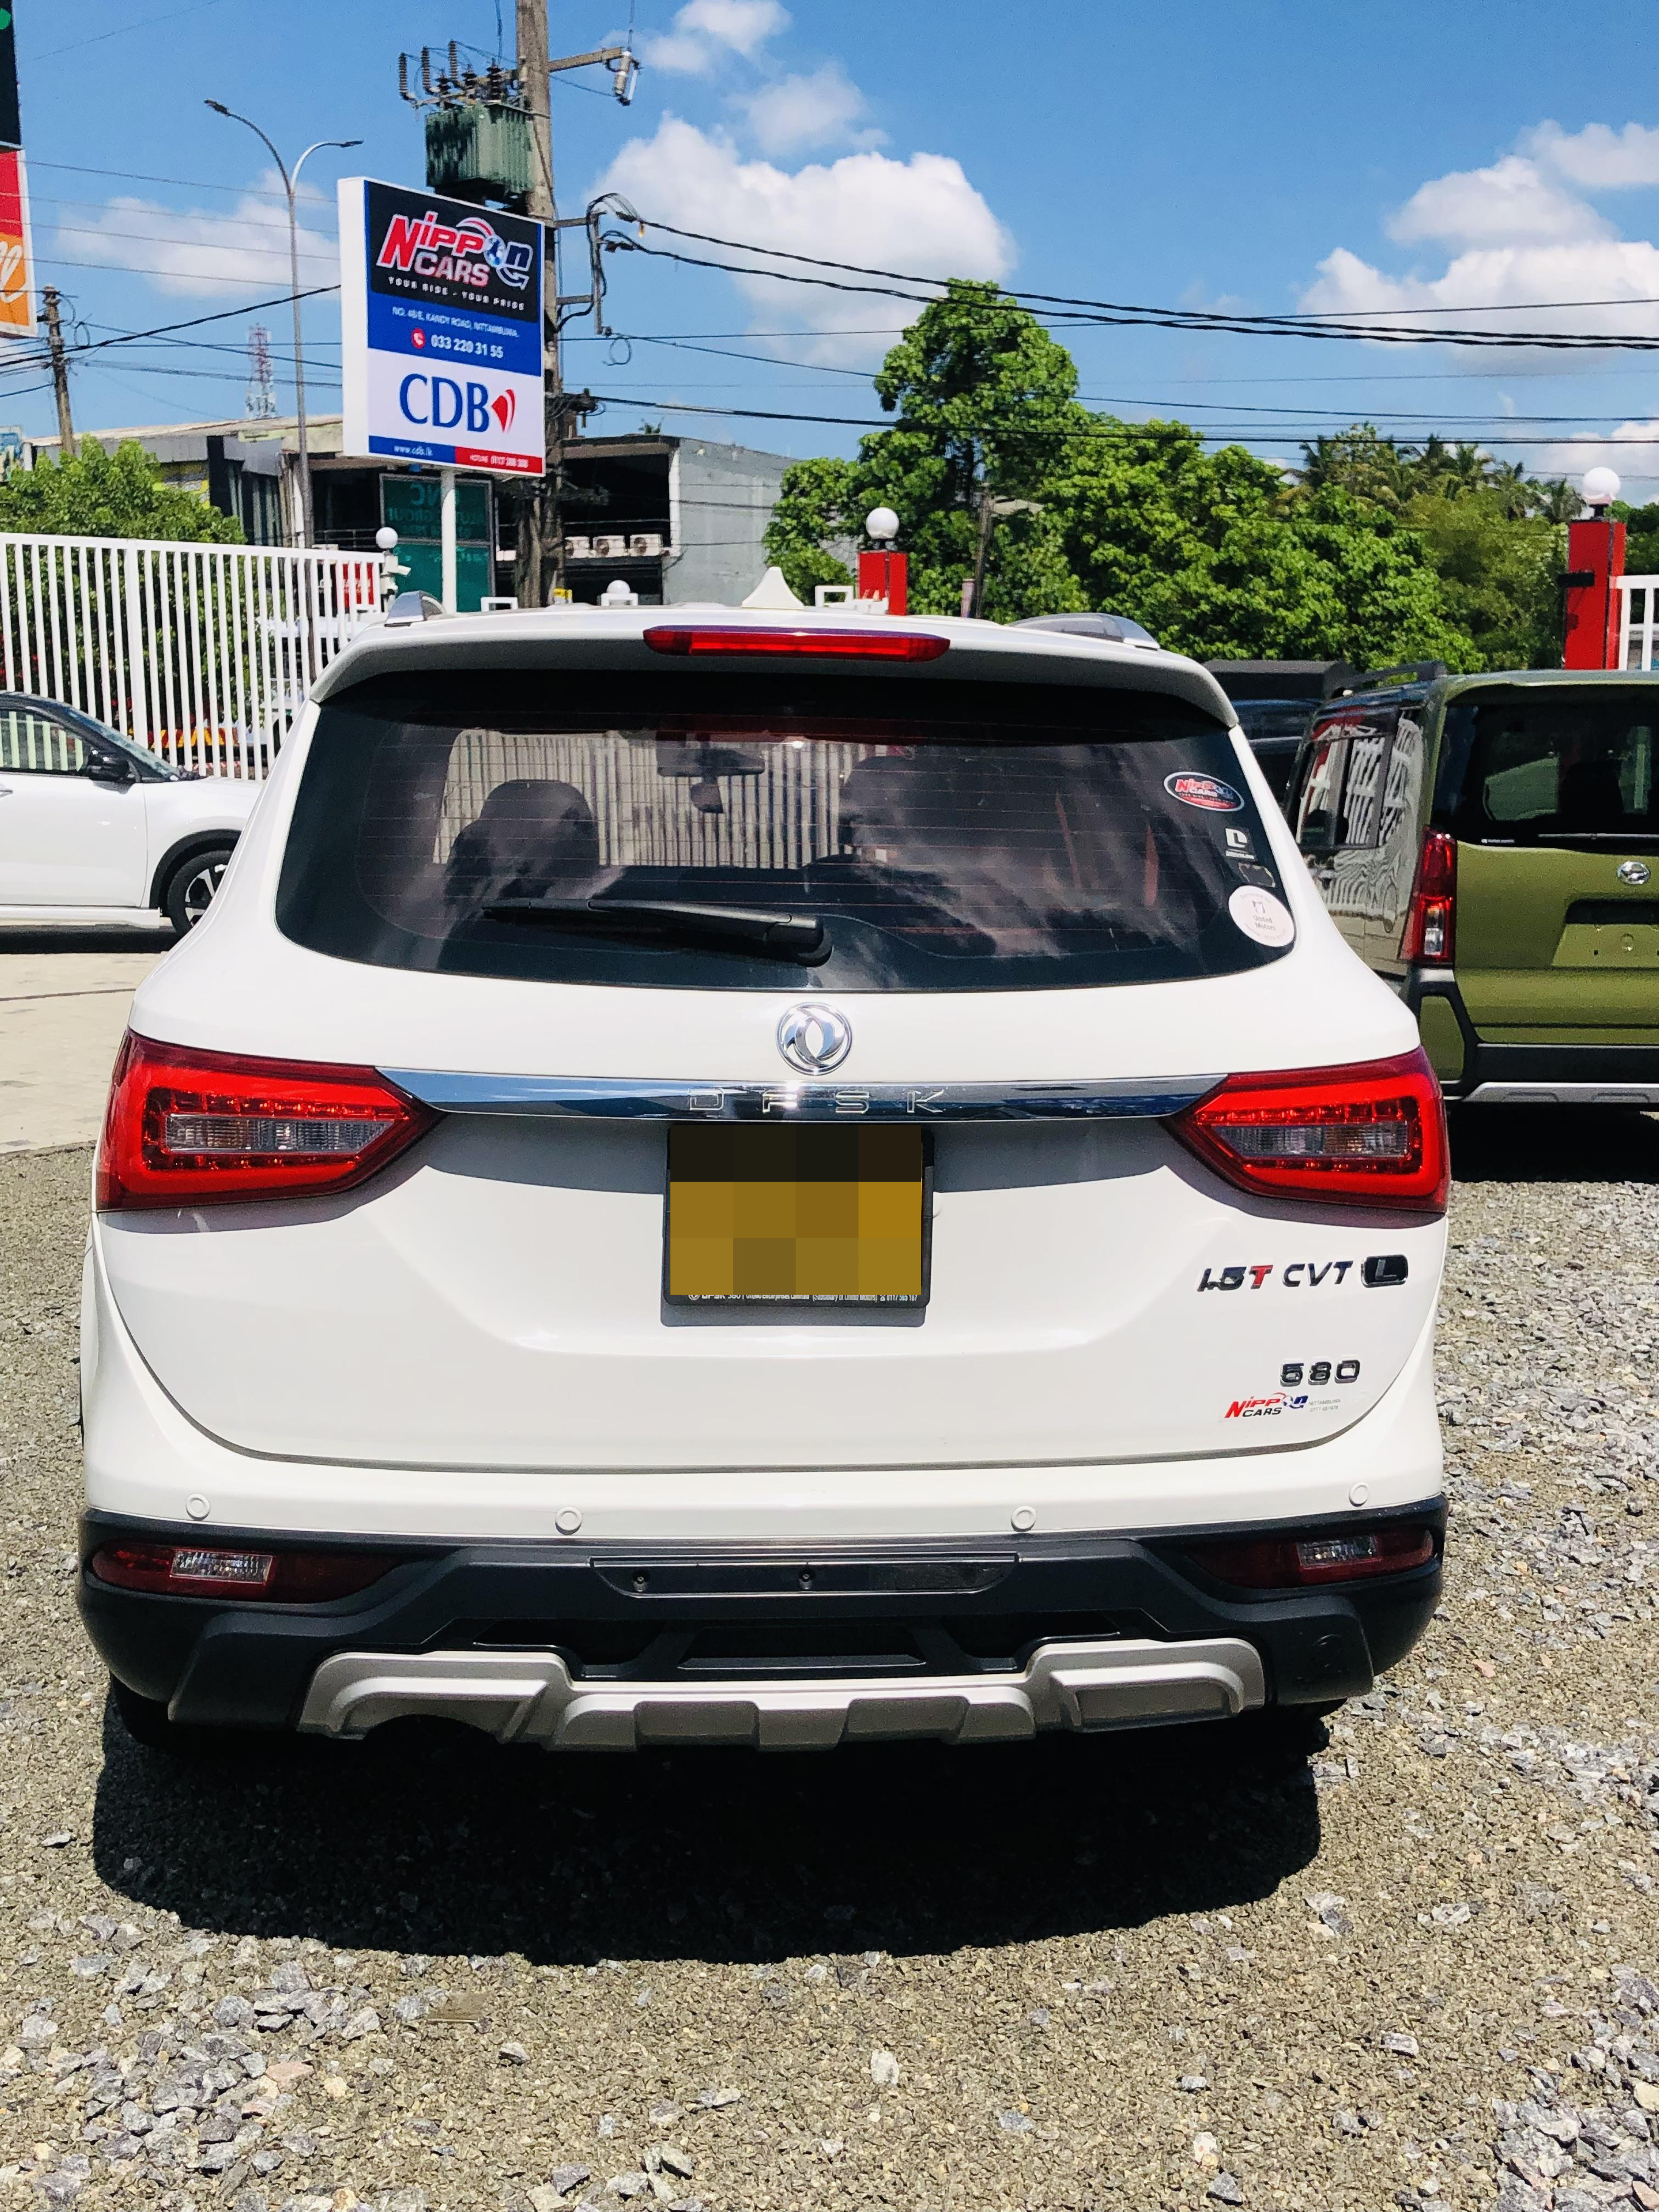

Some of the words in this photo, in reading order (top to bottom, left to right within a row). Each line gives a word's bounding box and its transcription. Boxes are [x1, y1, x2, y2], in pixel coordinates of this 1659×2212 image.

[414, 251, 490, 287] CARS
[388, 276, 417, 289] YOUR
[422, 283, 448, 296] RIDE
[462, 291, 489, 303] YOUR
[493, 298, 524, 311] PRIDE
[431, 334, 452, 349] 033
[475, 342, 488, 356] 31
[399, 373, 489, 433] CDB
[689, 1088, 944, 1114] DFSK
[1197, 1264, 1273, 1292] 1.5T
[1282, 1260, 1354, 1288] CVT
[1280, 1359, 1361, 1387] 580
[1242, 1407, 1283, 1417] CARS
